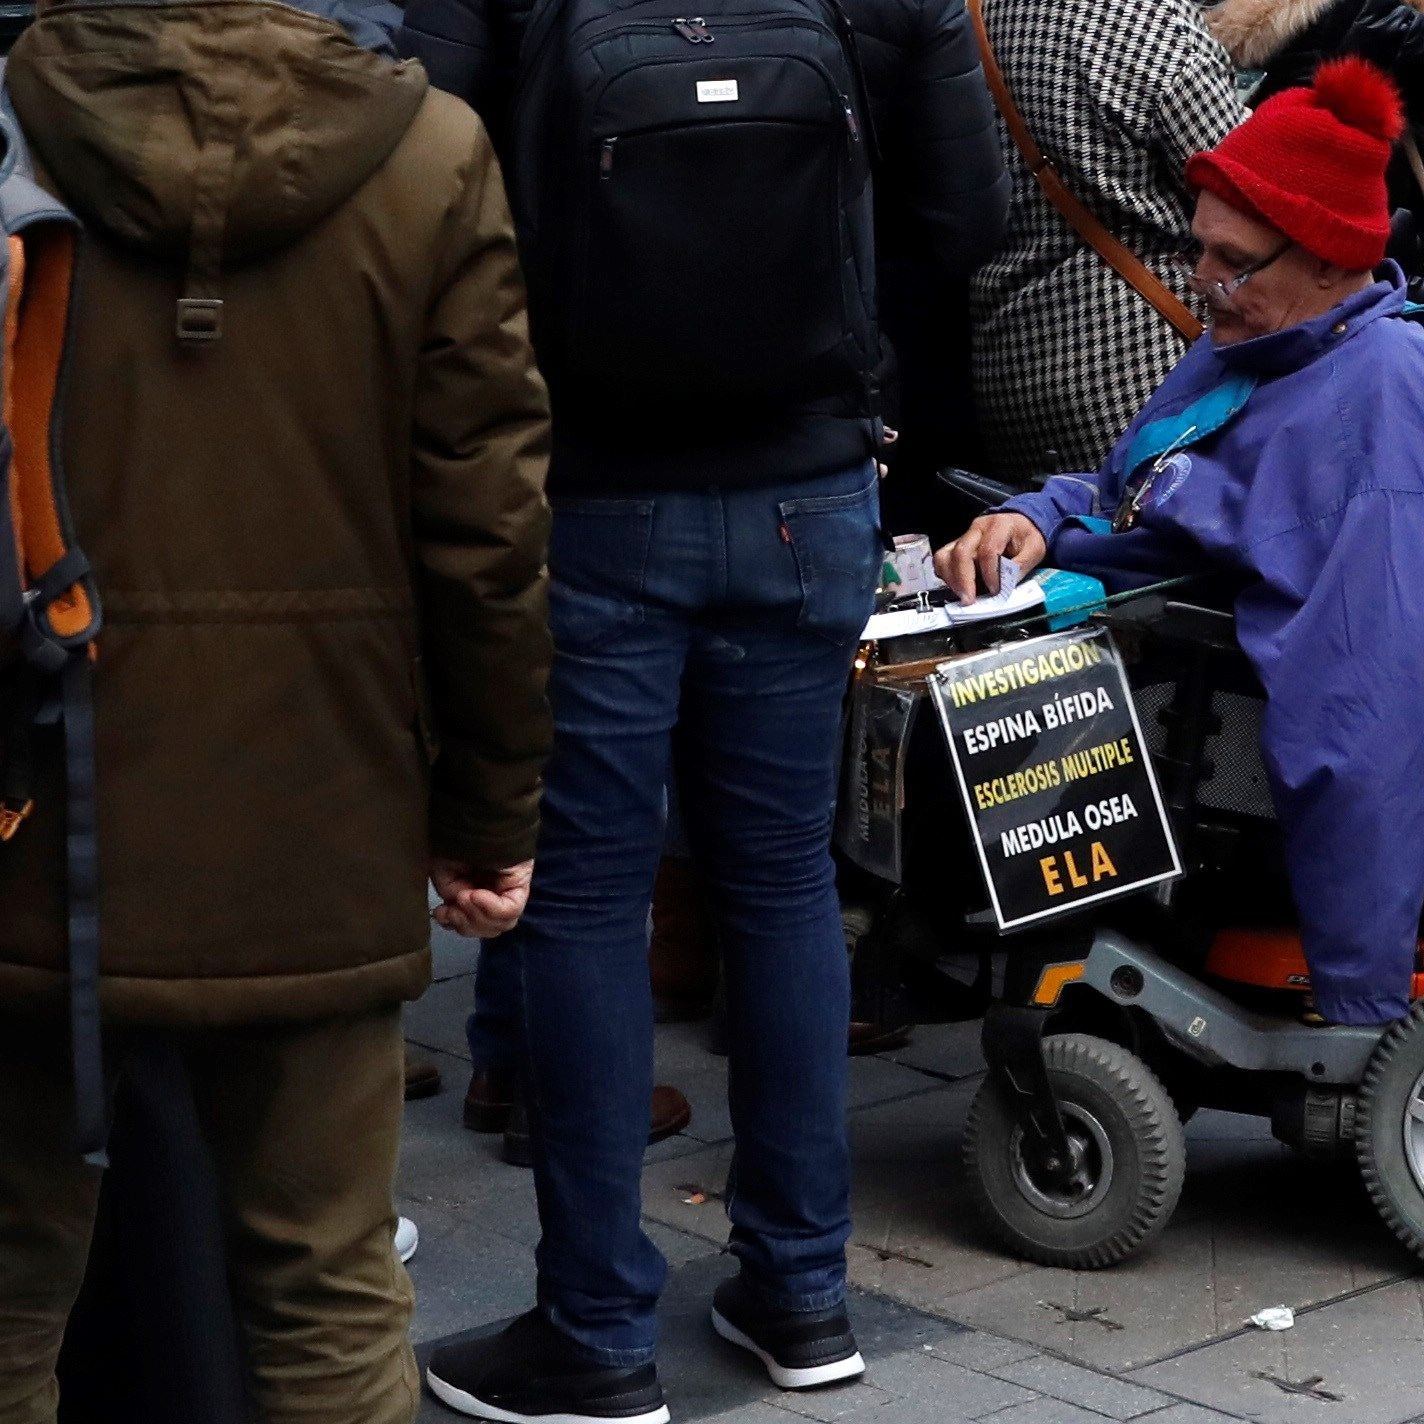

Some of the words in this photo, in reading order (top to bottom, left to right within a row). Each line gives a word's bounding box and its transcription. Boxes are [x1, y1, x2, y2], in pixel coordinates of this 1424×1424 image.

[949, 638, 1103, 708] INVESTIGACIÓN
[963, 710, 1042, 755] ESPINA
[1042, 686, 1114, 732] BÍFIDA
[974, 761, 1062, 811] ESCLEROSIS
[1061, 738, 1134, 784] MULTIPLE
[1000, 810, 1083, 858] MEDULA
[1084, 793, 1138, 832] OSEA
